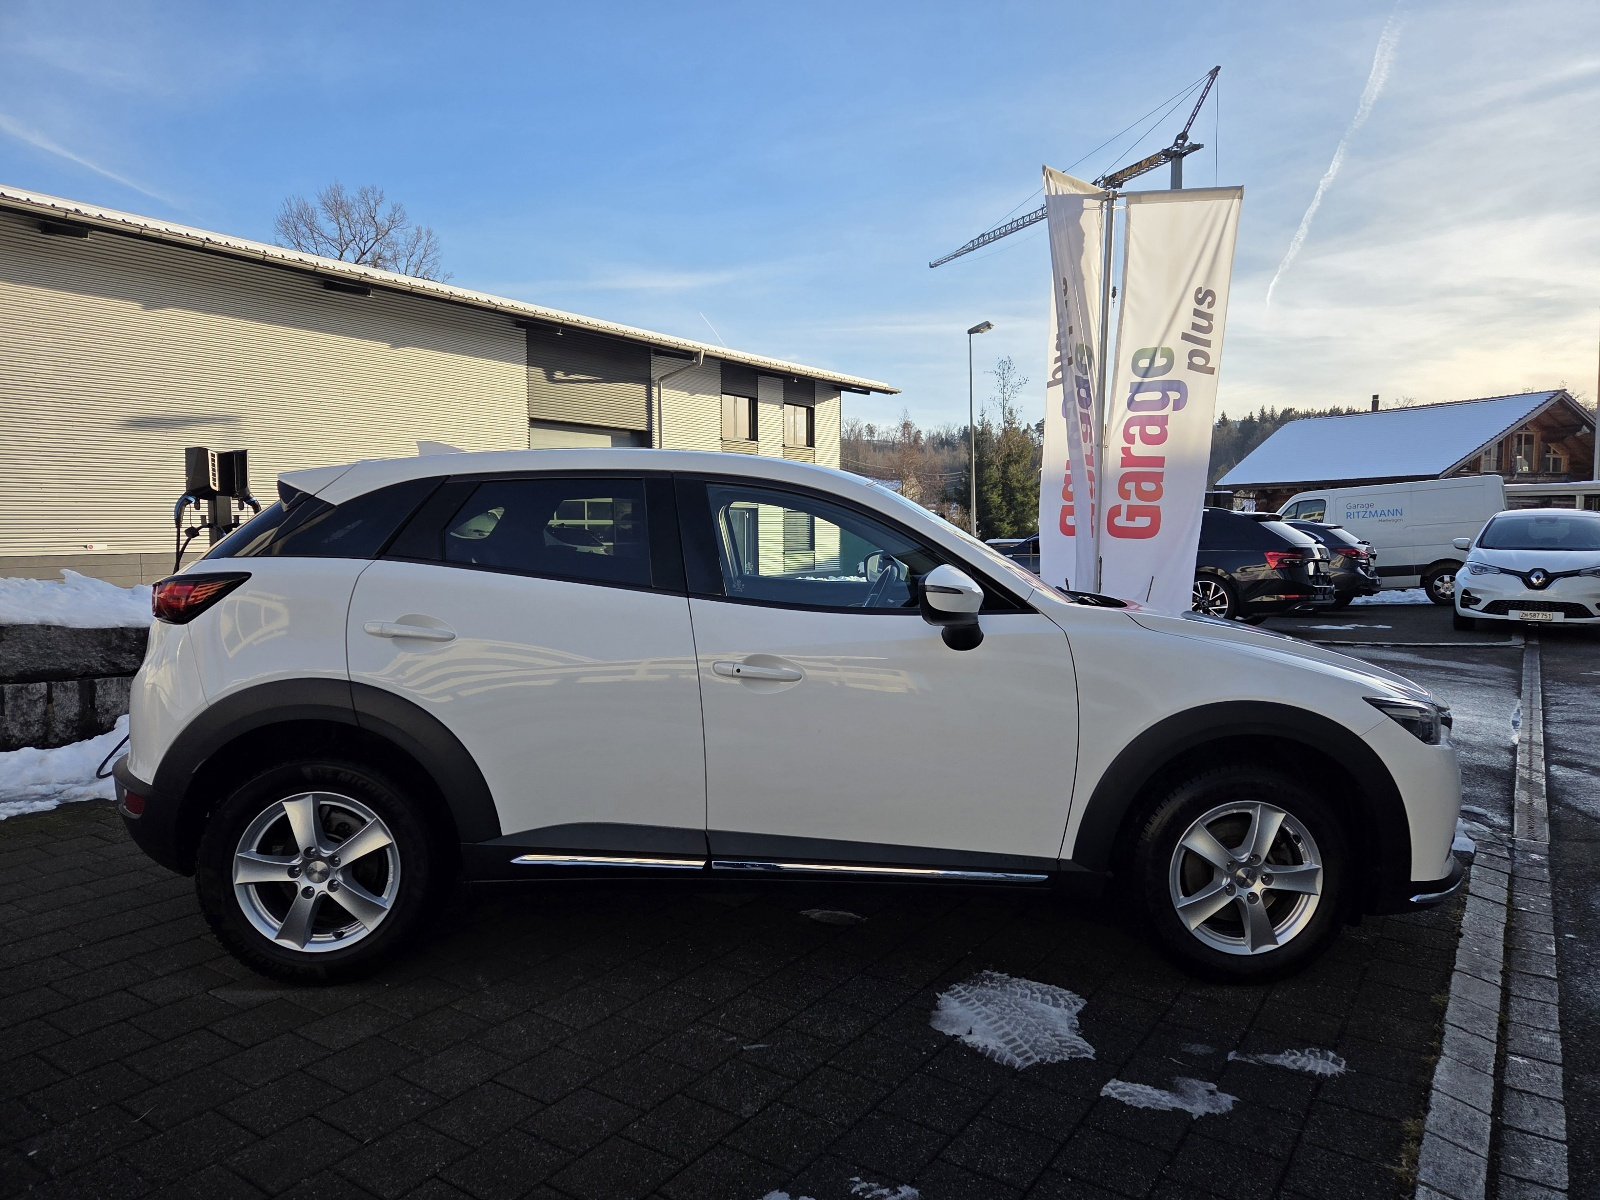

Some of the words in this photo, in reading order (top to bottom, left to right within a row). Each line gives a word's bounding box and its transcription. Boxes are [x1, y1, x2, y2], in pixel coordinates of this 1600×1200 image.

[1181, 286, 1217, 376] plus
[1106, 346, 1189, 540] Garage
[1346, 502, 1374, 510] Garage
[1346, 508, 1403, 519] RITZMANN
